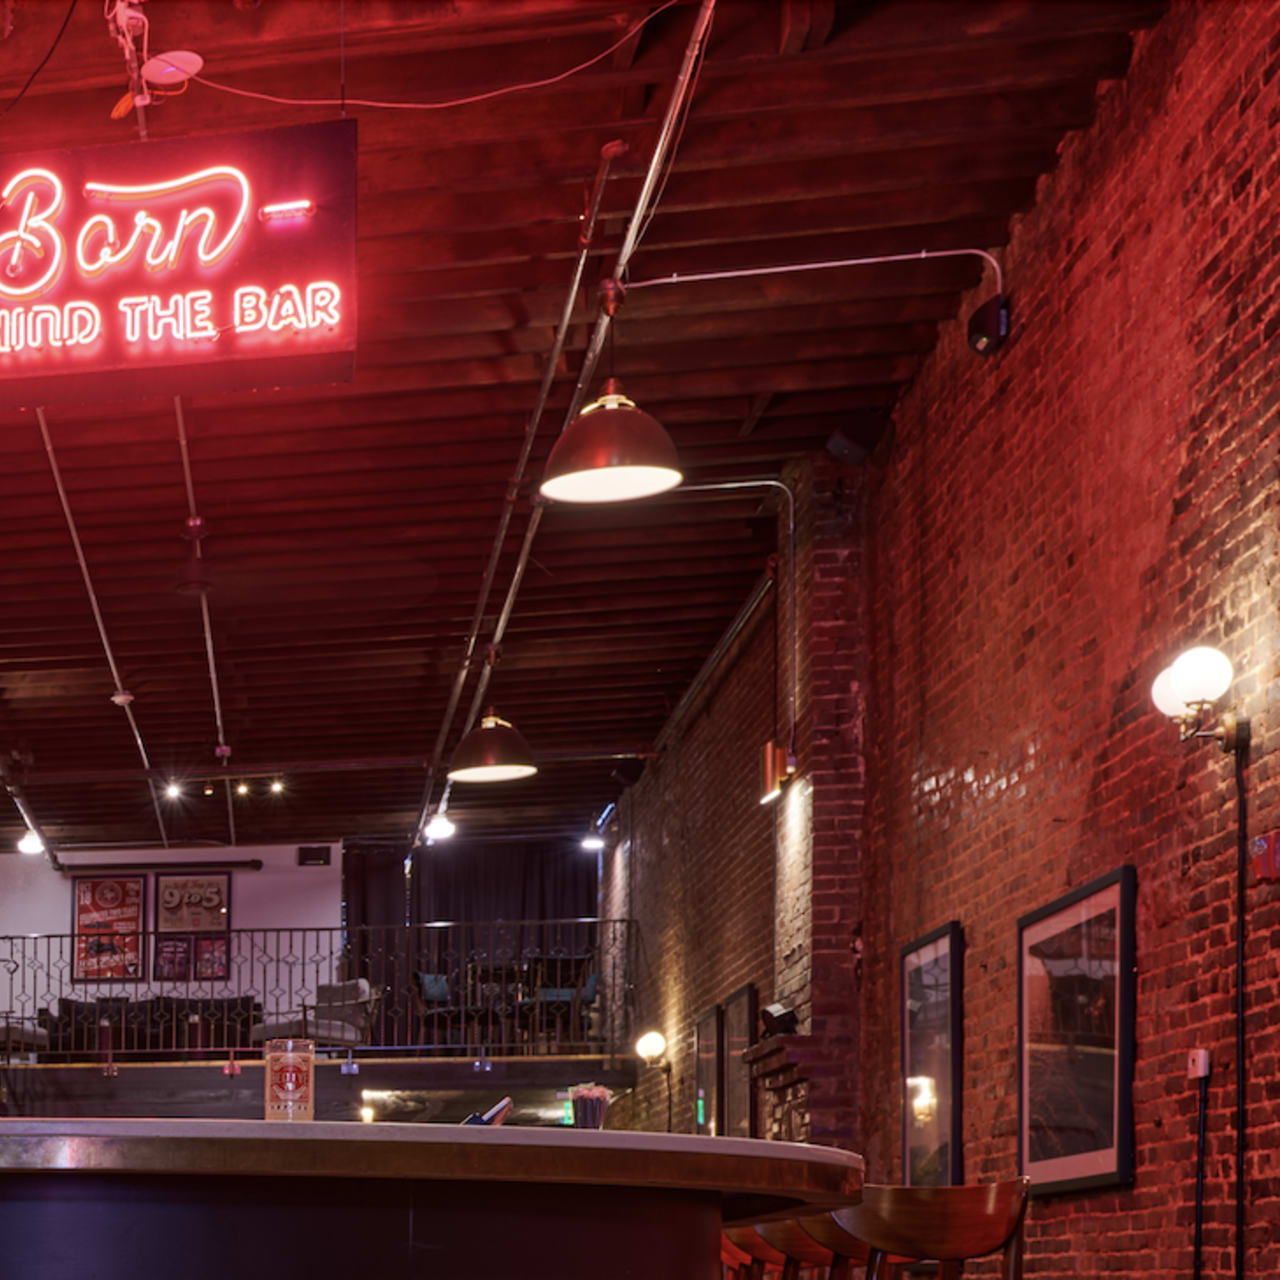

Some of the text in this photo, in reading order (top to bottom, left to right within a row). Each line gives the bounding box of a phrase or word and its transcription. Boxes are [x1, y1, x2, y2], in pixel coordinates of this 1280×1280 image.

[119, 290, 218, 342] THE
[235, 282, 340, 333] BAR
[163, 887, 180, 909] 9
[202, 887, 221, 908] 5
